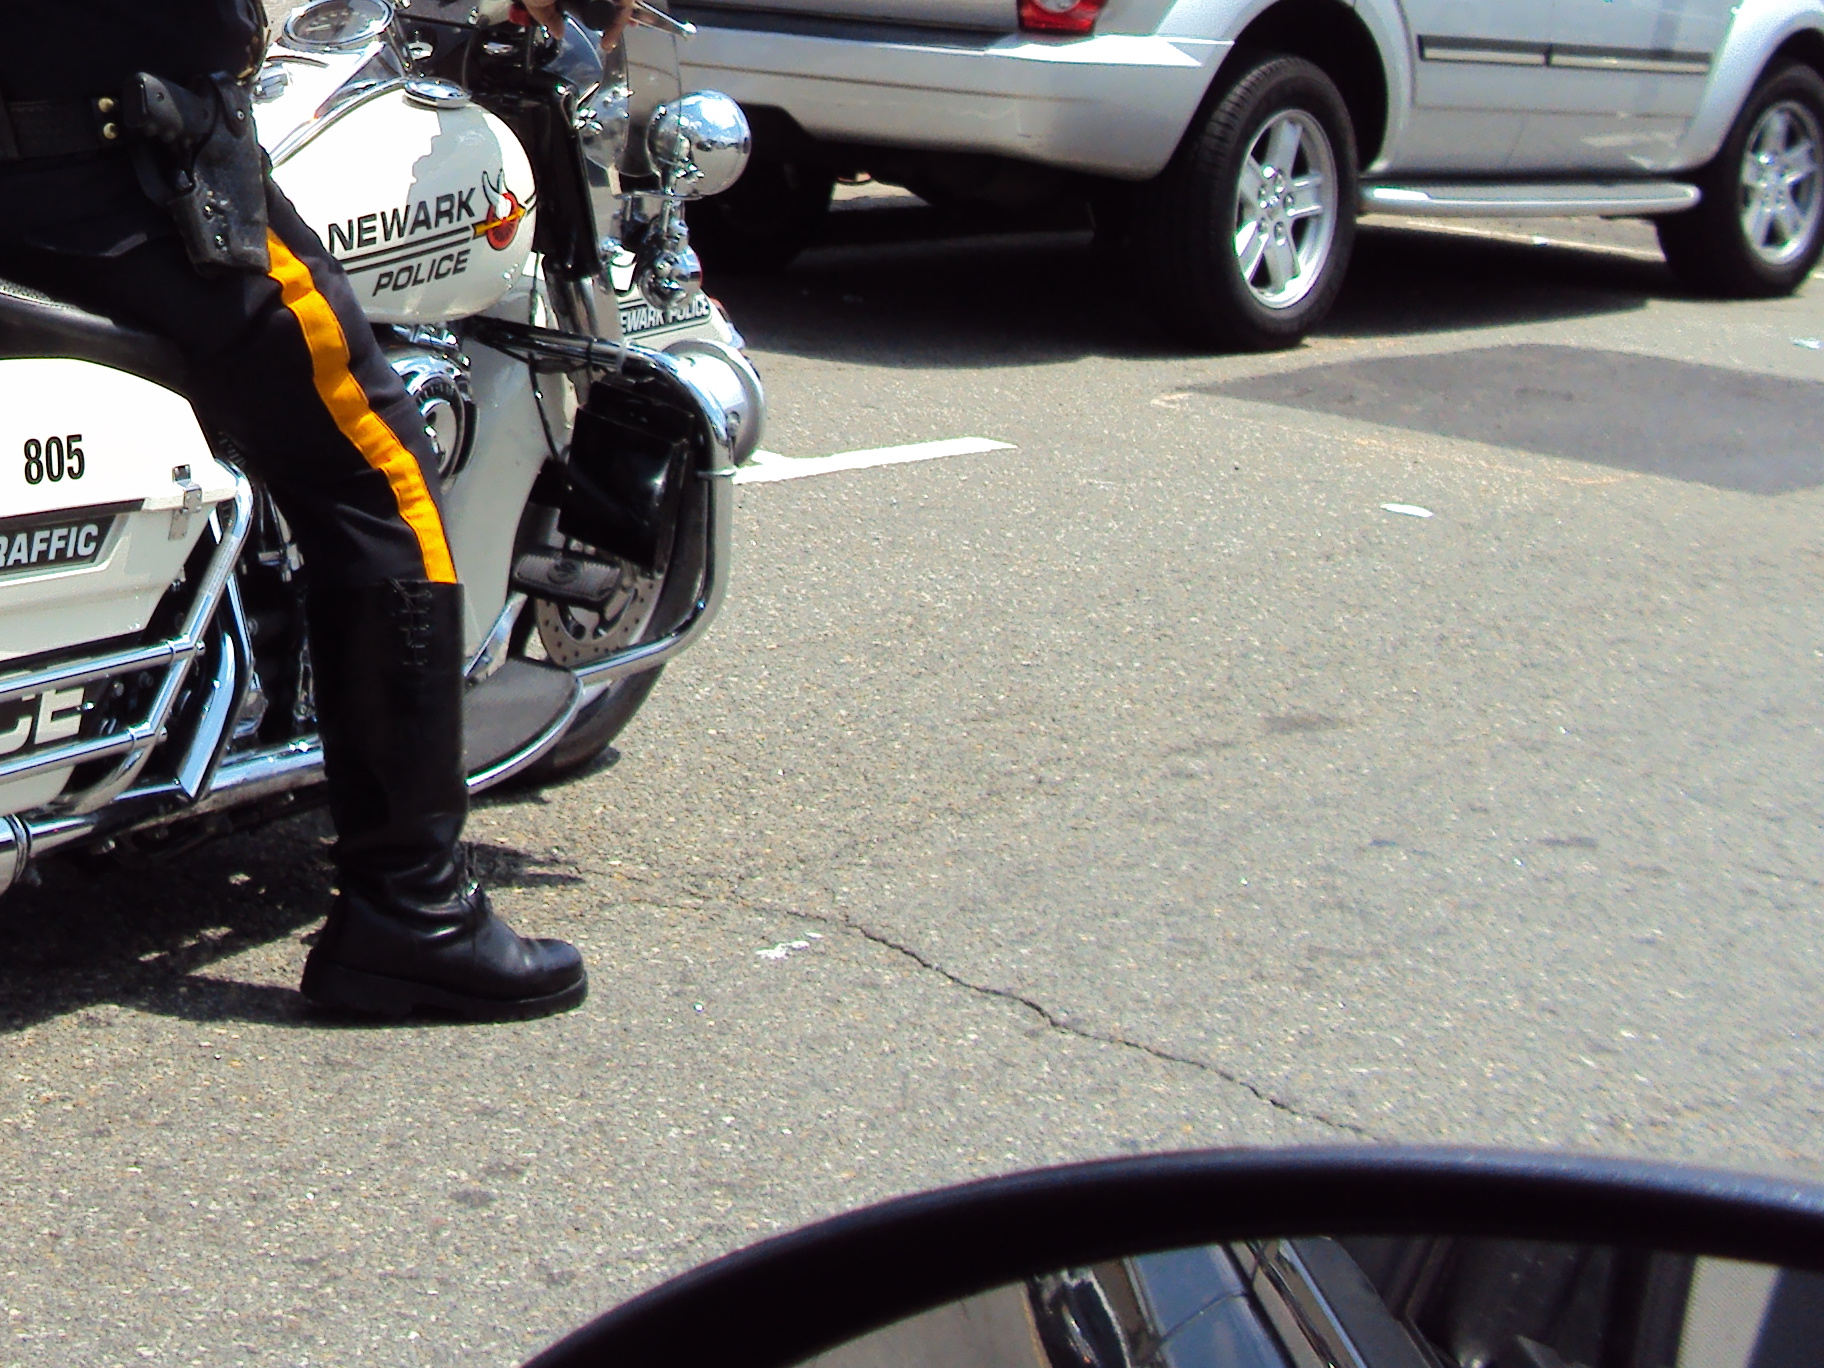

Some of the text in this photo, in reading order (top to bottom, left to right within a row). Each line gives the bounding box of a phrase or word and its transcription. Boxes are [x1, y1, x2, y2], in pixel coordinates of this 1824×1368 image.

[328, 187, 476, 254] NEWARK
[372, 249, 471, 297] POLICE
[620, 307, 664, 333] EWARK
[23, 434, 85, 485] 805
